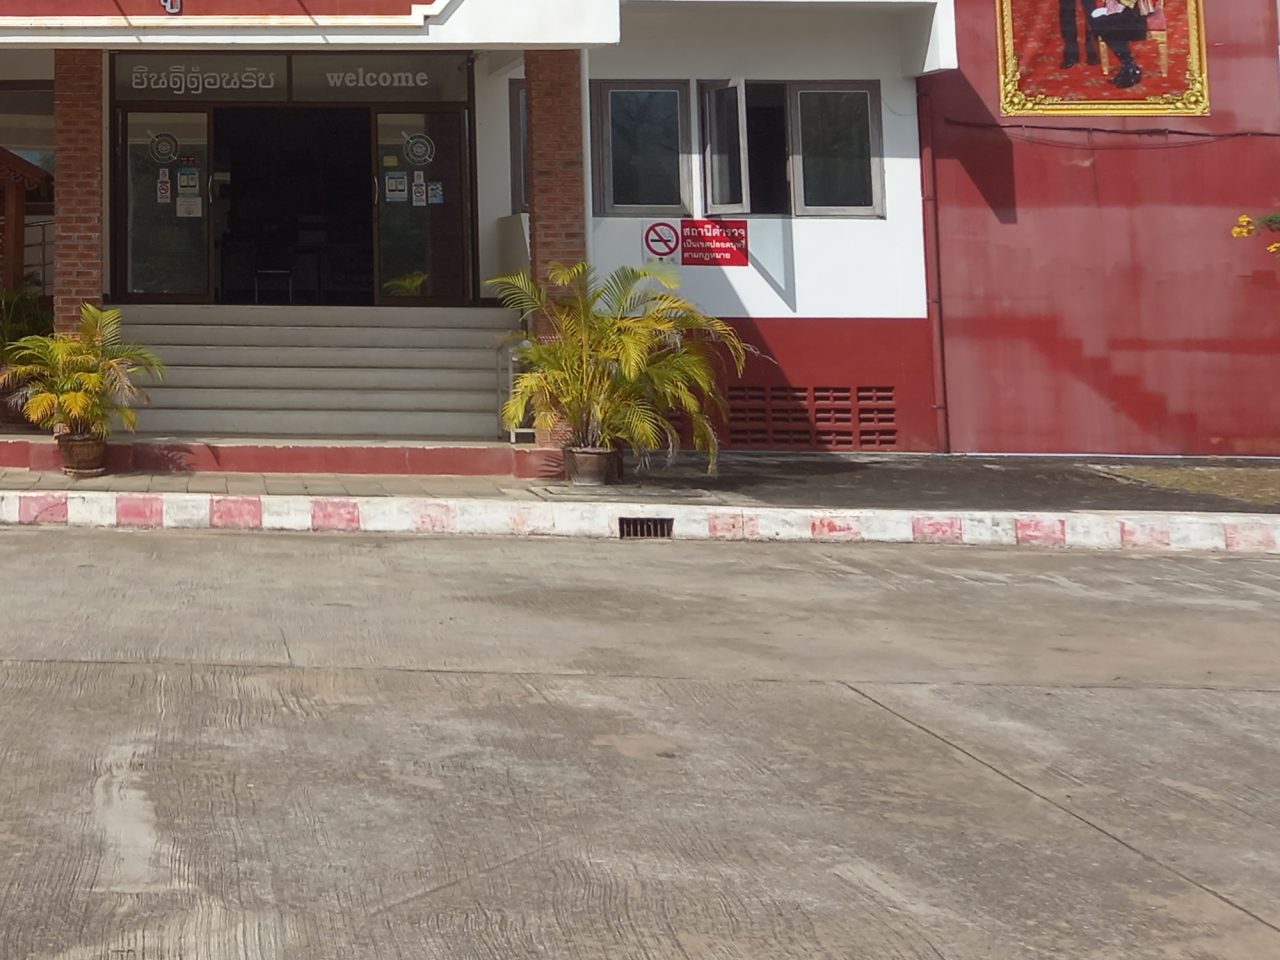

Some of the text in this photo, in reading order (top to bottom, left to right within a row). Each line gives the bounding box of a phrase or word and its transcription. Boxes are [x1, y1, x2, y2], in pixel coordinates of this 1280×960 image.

[325, 68, 429, 88] welcome
[683, 224, 746, 237] สถานีตำรวจ
